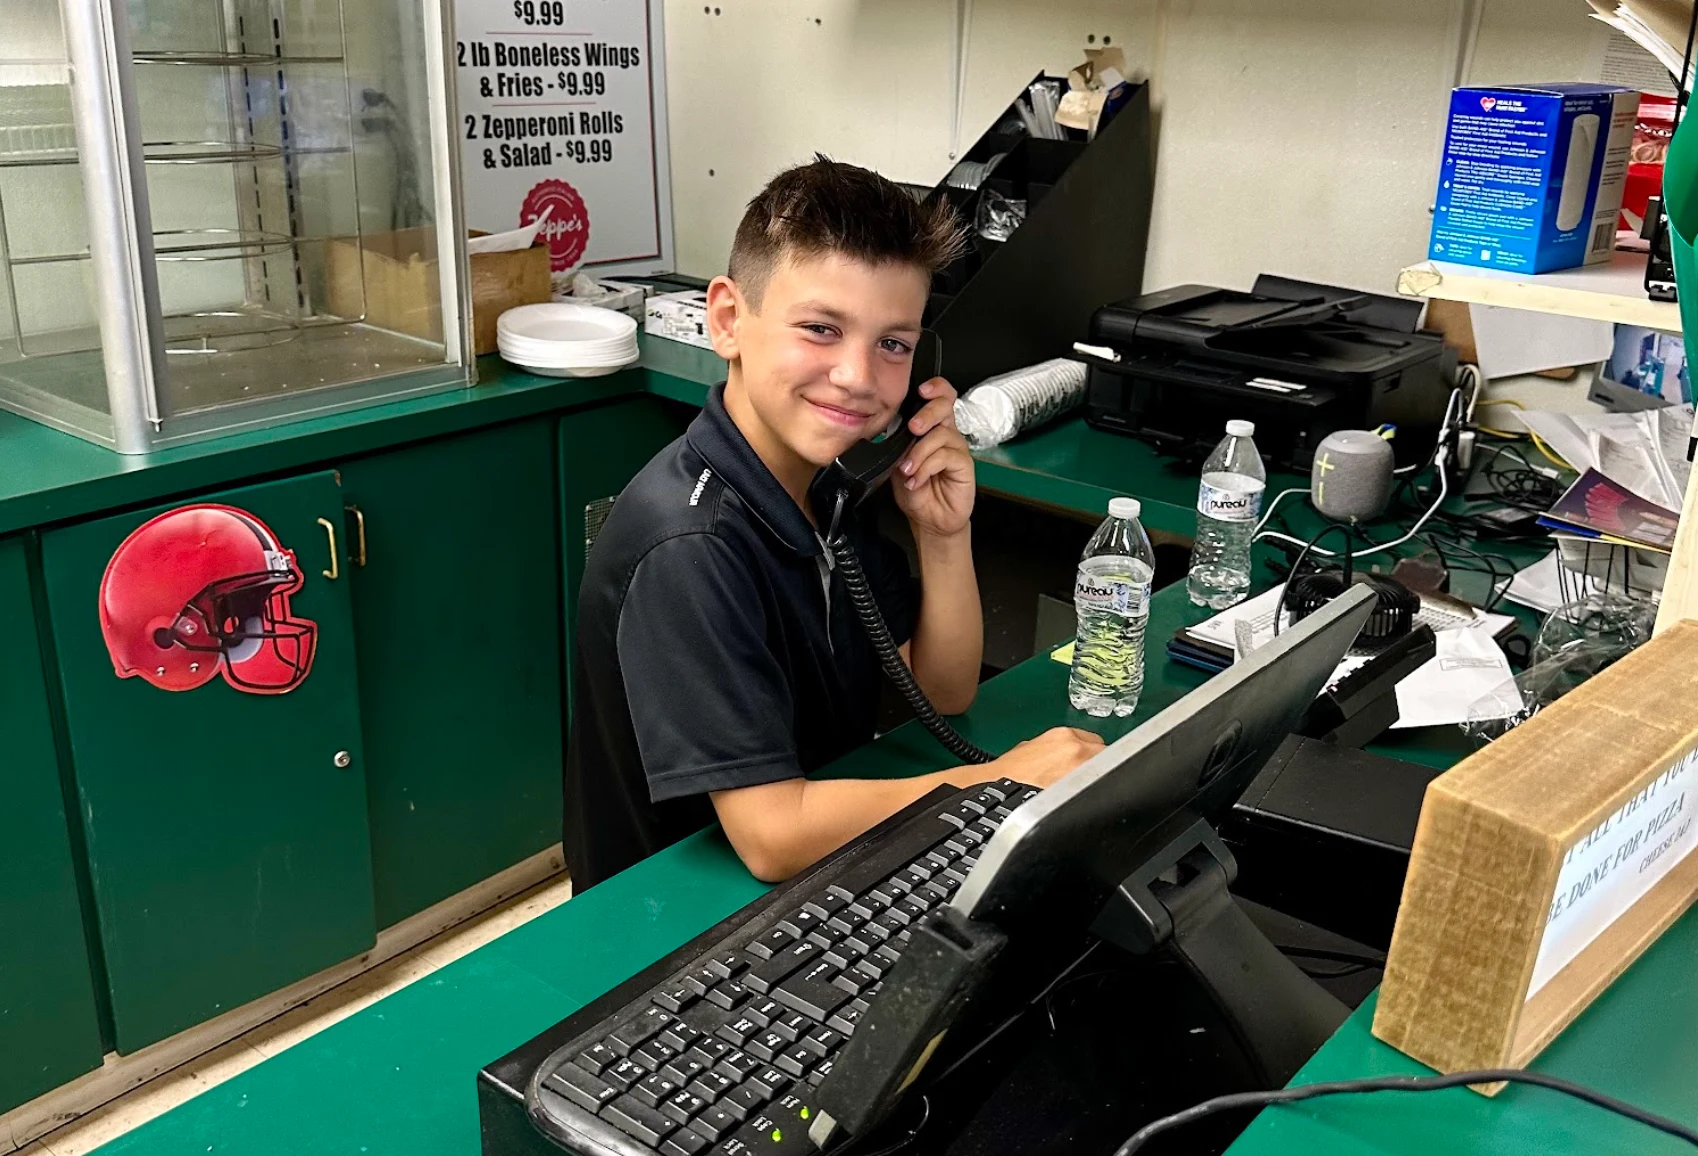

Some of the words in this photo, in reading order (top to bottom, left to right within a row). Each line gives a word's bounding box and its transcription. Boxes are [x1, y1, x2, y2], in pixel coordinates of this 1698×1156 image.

[513, 0, 564, 26] $9.99
[456, 41, 467, 67] 2
[470, 41, 491, 67] lb
[494, 41, 581, 67] Boneless
[584, 42, 640, 70] Wings
[480, 76, 494, 98] &
[497, 72, 544, 97] Fries
[557, 71, 605, 96] $9.99
[464, 114, 478, 140] 2
[481, 111, 576, 140] Zepperoni
[579, 111, 624, 135] Rolls
[483, 148, 497, 170] &
[499, 142, 552, 169] Salad
[565, 138, 613, 164] $9.99
[1210, 499, 1247, 510] pureau
[1076, 583, 1113, 596] pureau
[1566, 853, 1613, 909] DONE
[1612, 829, 1643, 870] FOR
[1642, 791, 1686, 844] PIZZA
